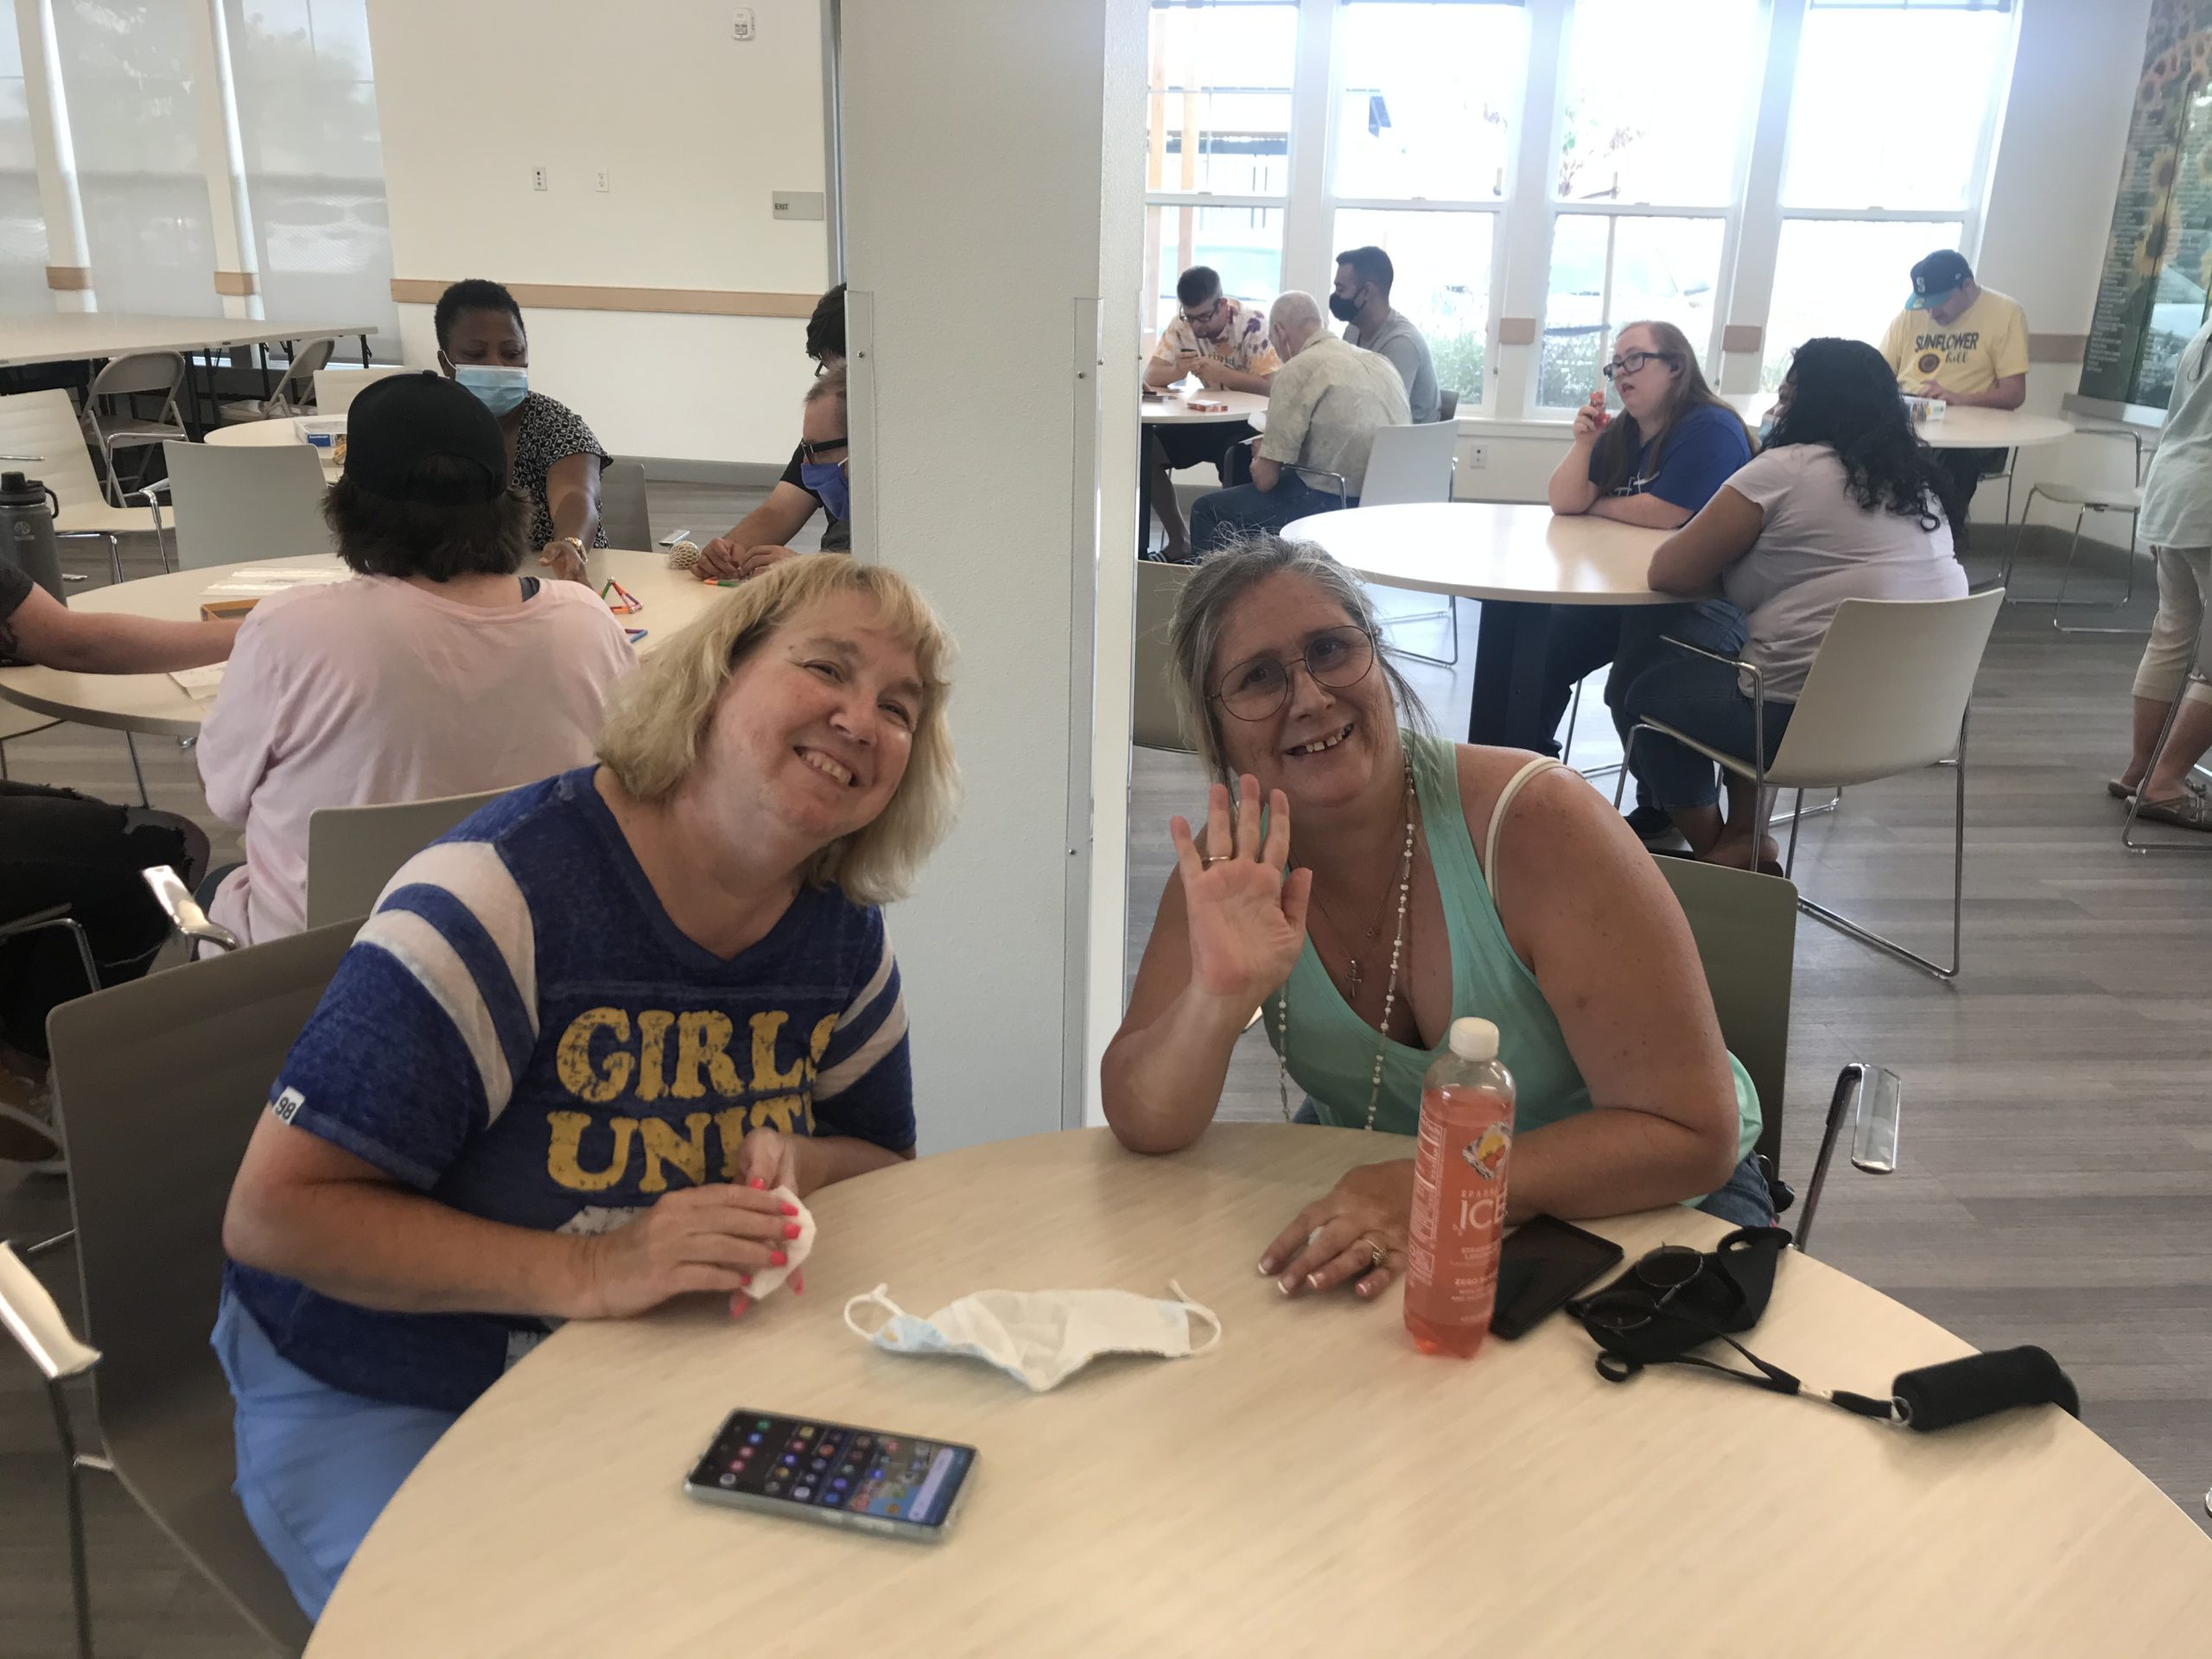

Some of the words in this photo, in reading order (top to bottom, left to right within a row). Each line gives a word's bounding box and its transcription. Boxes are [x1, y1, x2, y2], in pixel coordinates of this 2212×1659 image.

[1916, 276, 1926, 293] S
[1915, 332, 1979, 353] SUNFLOWER
[275, 1096, 296, 1120] 98
